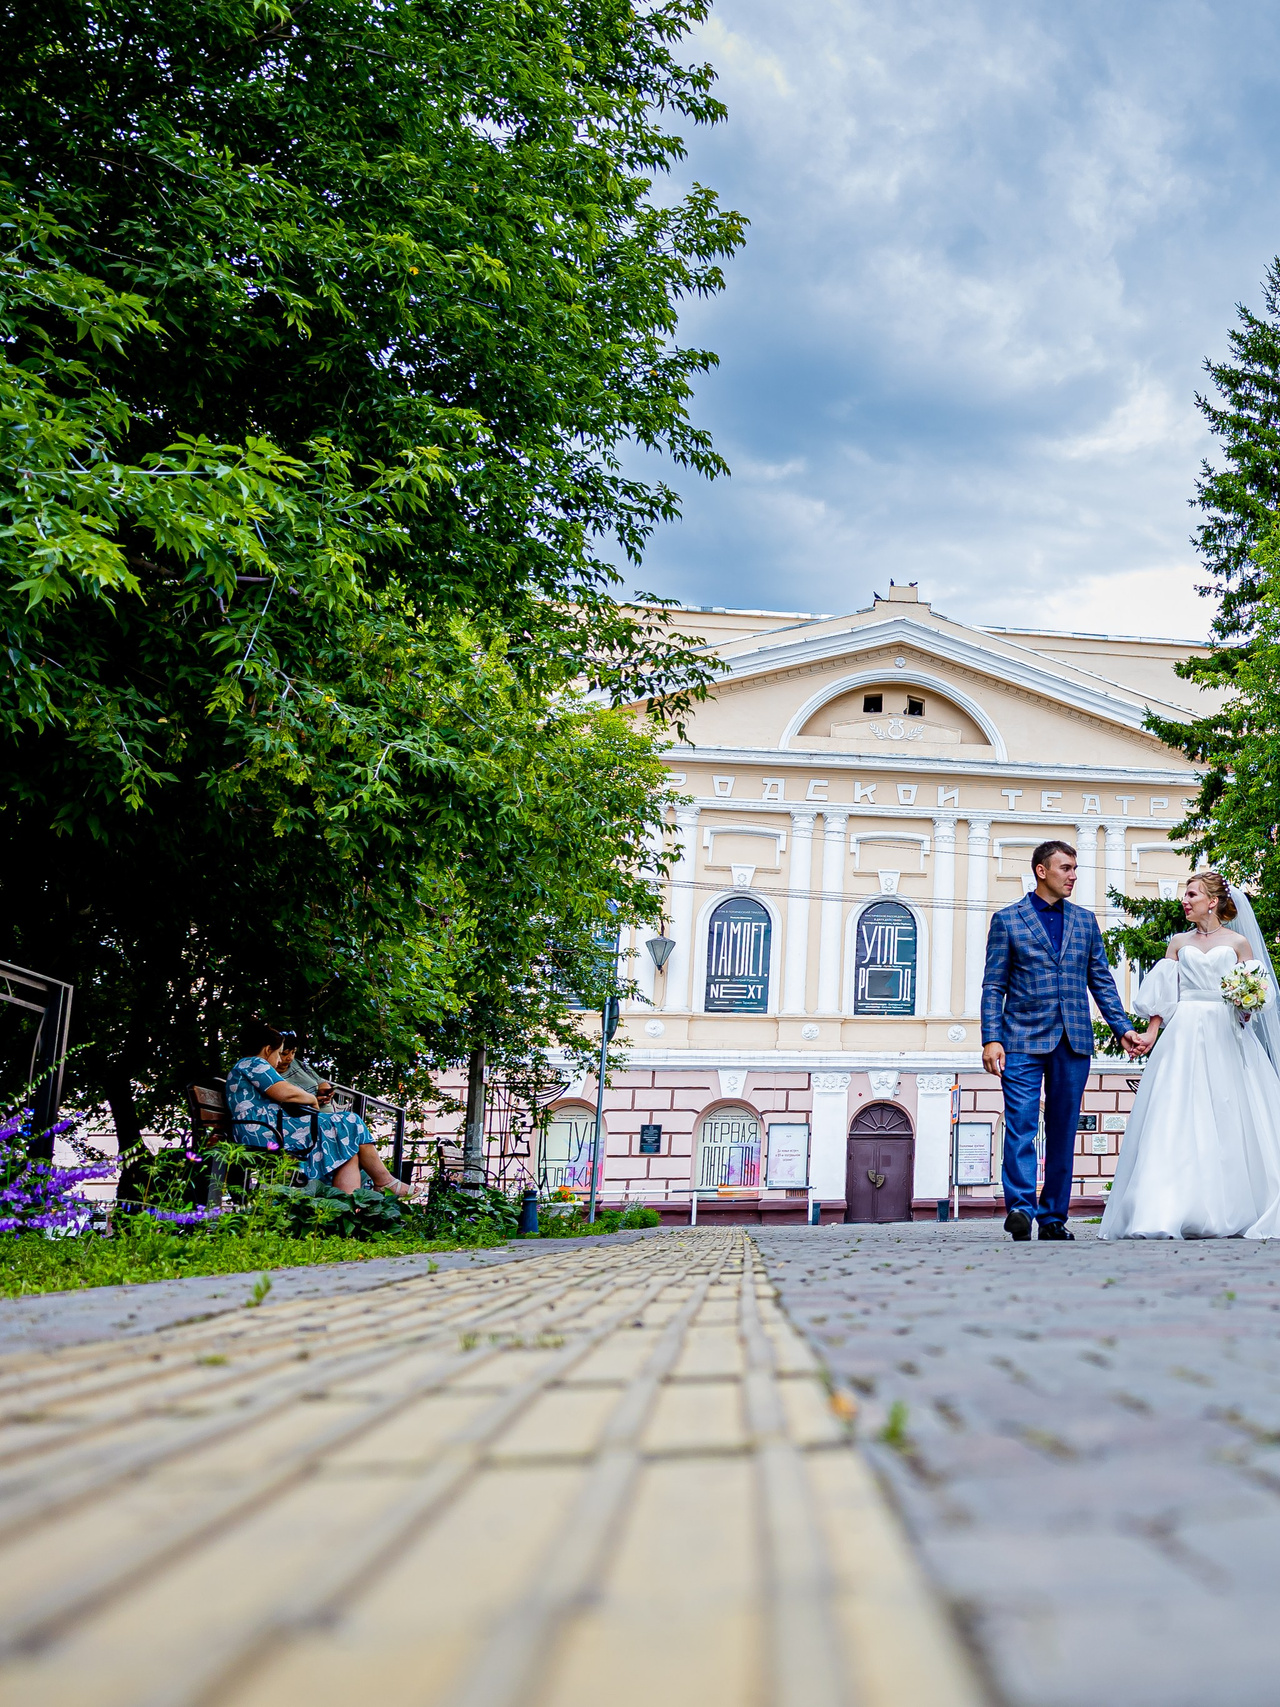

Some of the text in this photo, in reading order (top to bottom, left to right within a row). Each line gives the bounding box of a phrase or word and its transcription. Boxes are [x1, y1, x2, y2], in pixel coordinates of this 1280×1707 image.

[1001, 789, 1169, 816] ТЕАТР
[711, 921, 768, 977] ГАМЛЕТ.
[861, 925, 913, 965] УГЛЕ
[709, 983, 764, 999] NEXT
[857, 967, 911, 1001] РОД
[702, 1122, 758, 1143] ПЕРВАЯ
[699, 1146, 756, 1187] ЛЮБОВЬ
